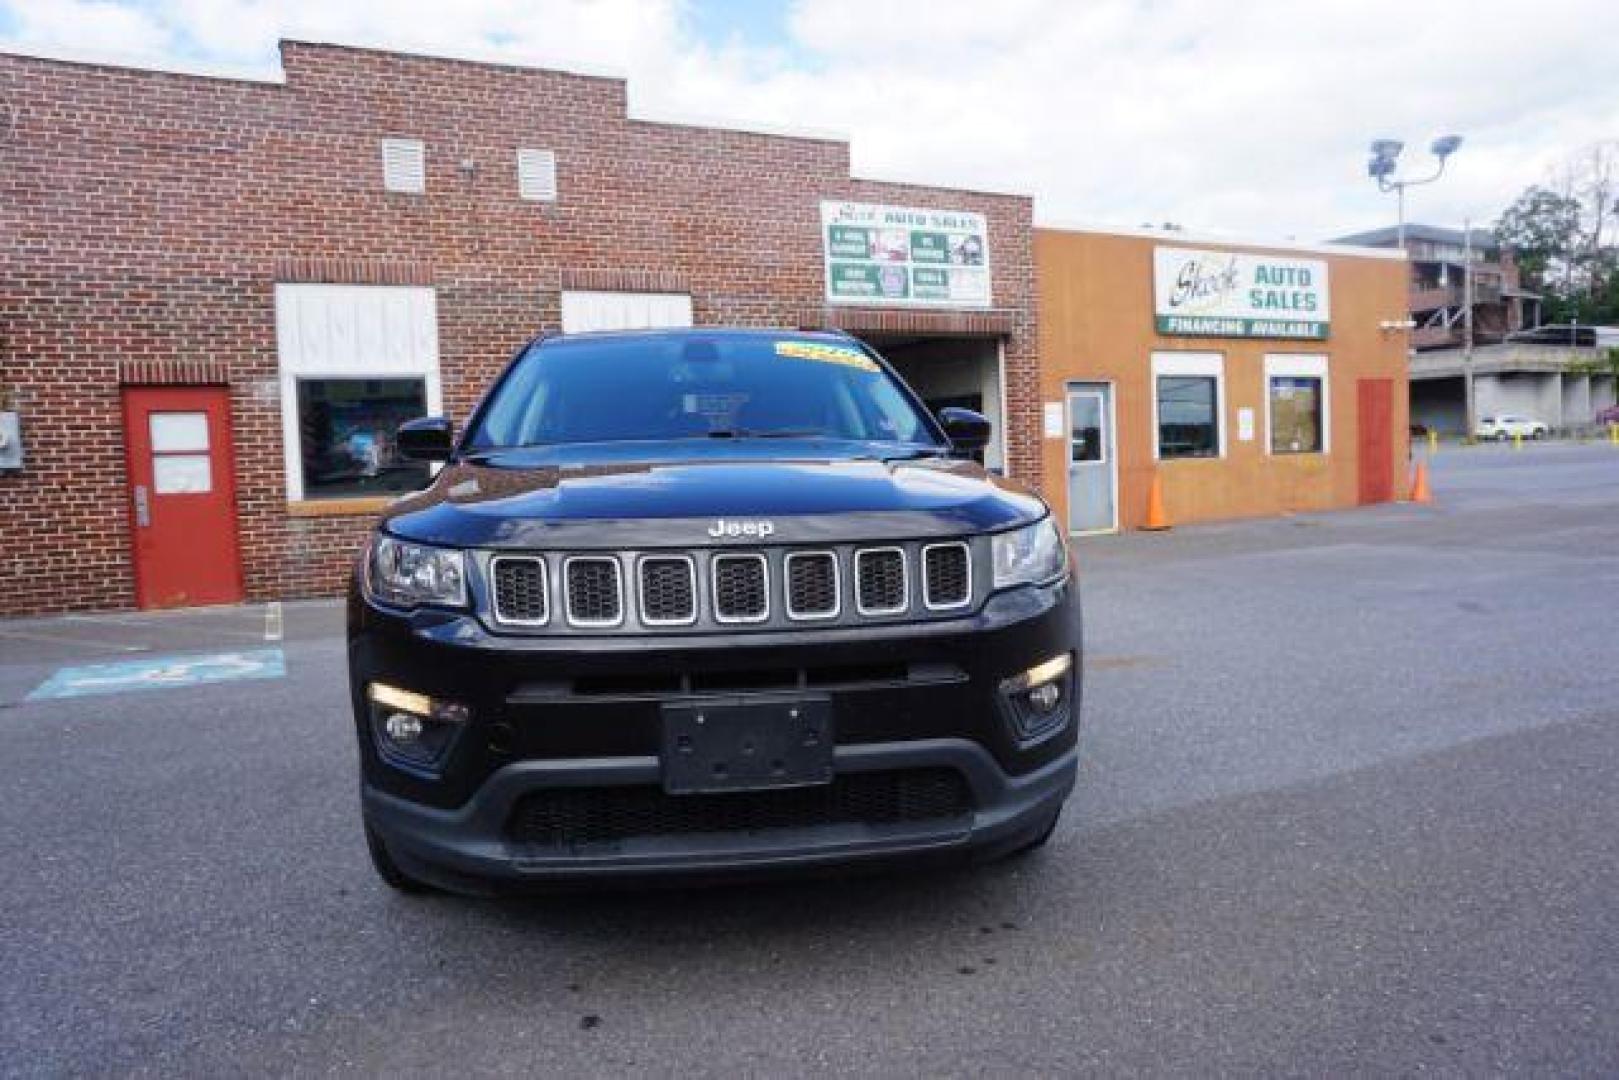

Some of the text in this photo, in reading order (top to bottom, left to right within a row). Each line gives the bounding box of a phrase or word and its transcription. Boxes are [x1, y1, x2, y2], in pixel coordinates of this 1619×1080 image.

[1255, 265, 1312, 287] AUTO
[1250, 288, 1317, 312] SALES
[708, 519, 774, 539] Jeep
